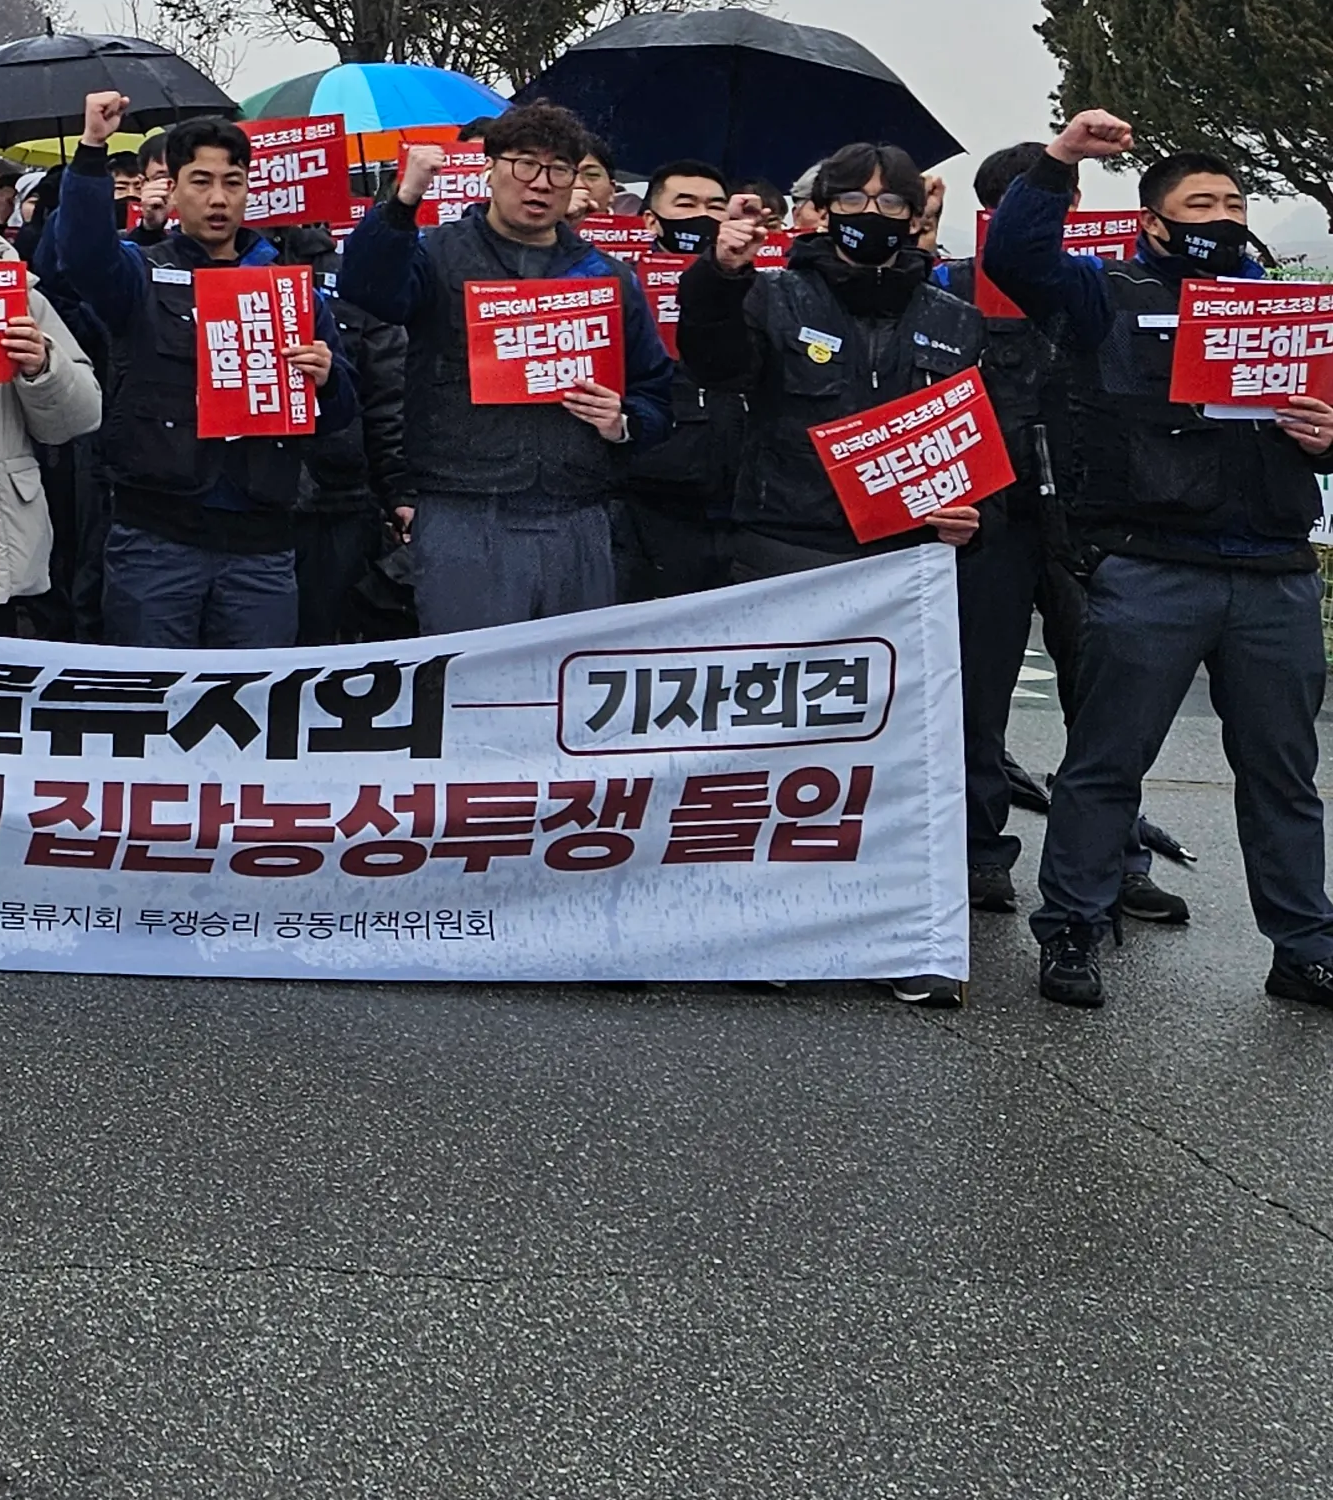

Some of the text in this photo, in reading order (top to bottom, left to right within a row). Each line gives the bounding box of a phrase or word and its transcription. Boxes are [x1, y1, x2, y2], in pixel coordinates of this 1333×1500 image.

[250, 122, 335, 149] 구조조정 중단!
[248, 148, 329, 189] 단해고
[1104, 219, 1137, 235] 중단!
[479, 298, 536, 318] 한국GM
[538, 291, 588, 311] 구조조정
[1192, 300, 1254, 316] 한국GM
[1257, 296, 1315, 315] 구조조정
[206, 320, 242, 389] 철회!
[238, 291, 281, 415] 집단해고
[494, 316, 610, 360] 집단해고
[1203, 322, 1333, 360] 집단해고
[1231, 362, 1308, 397] 철회!
[830, 425, 891, 460] 한국GM
[888, 397, 945, 434] 구조조정
[944, 380, 975, 409] 중단!
[855, 412, 982, 496] 집단해고
[899, 460, 973, 519] 철회!
[585, 657, 870, 734] 기자회견
[24, 777, 654, 878] 집단농성투쟁
[661, 765, 874, 865] 돌입
[135, 909, 260, 938] 투쟁승리
[273, 909, 496, 941] 공동대책위원회
